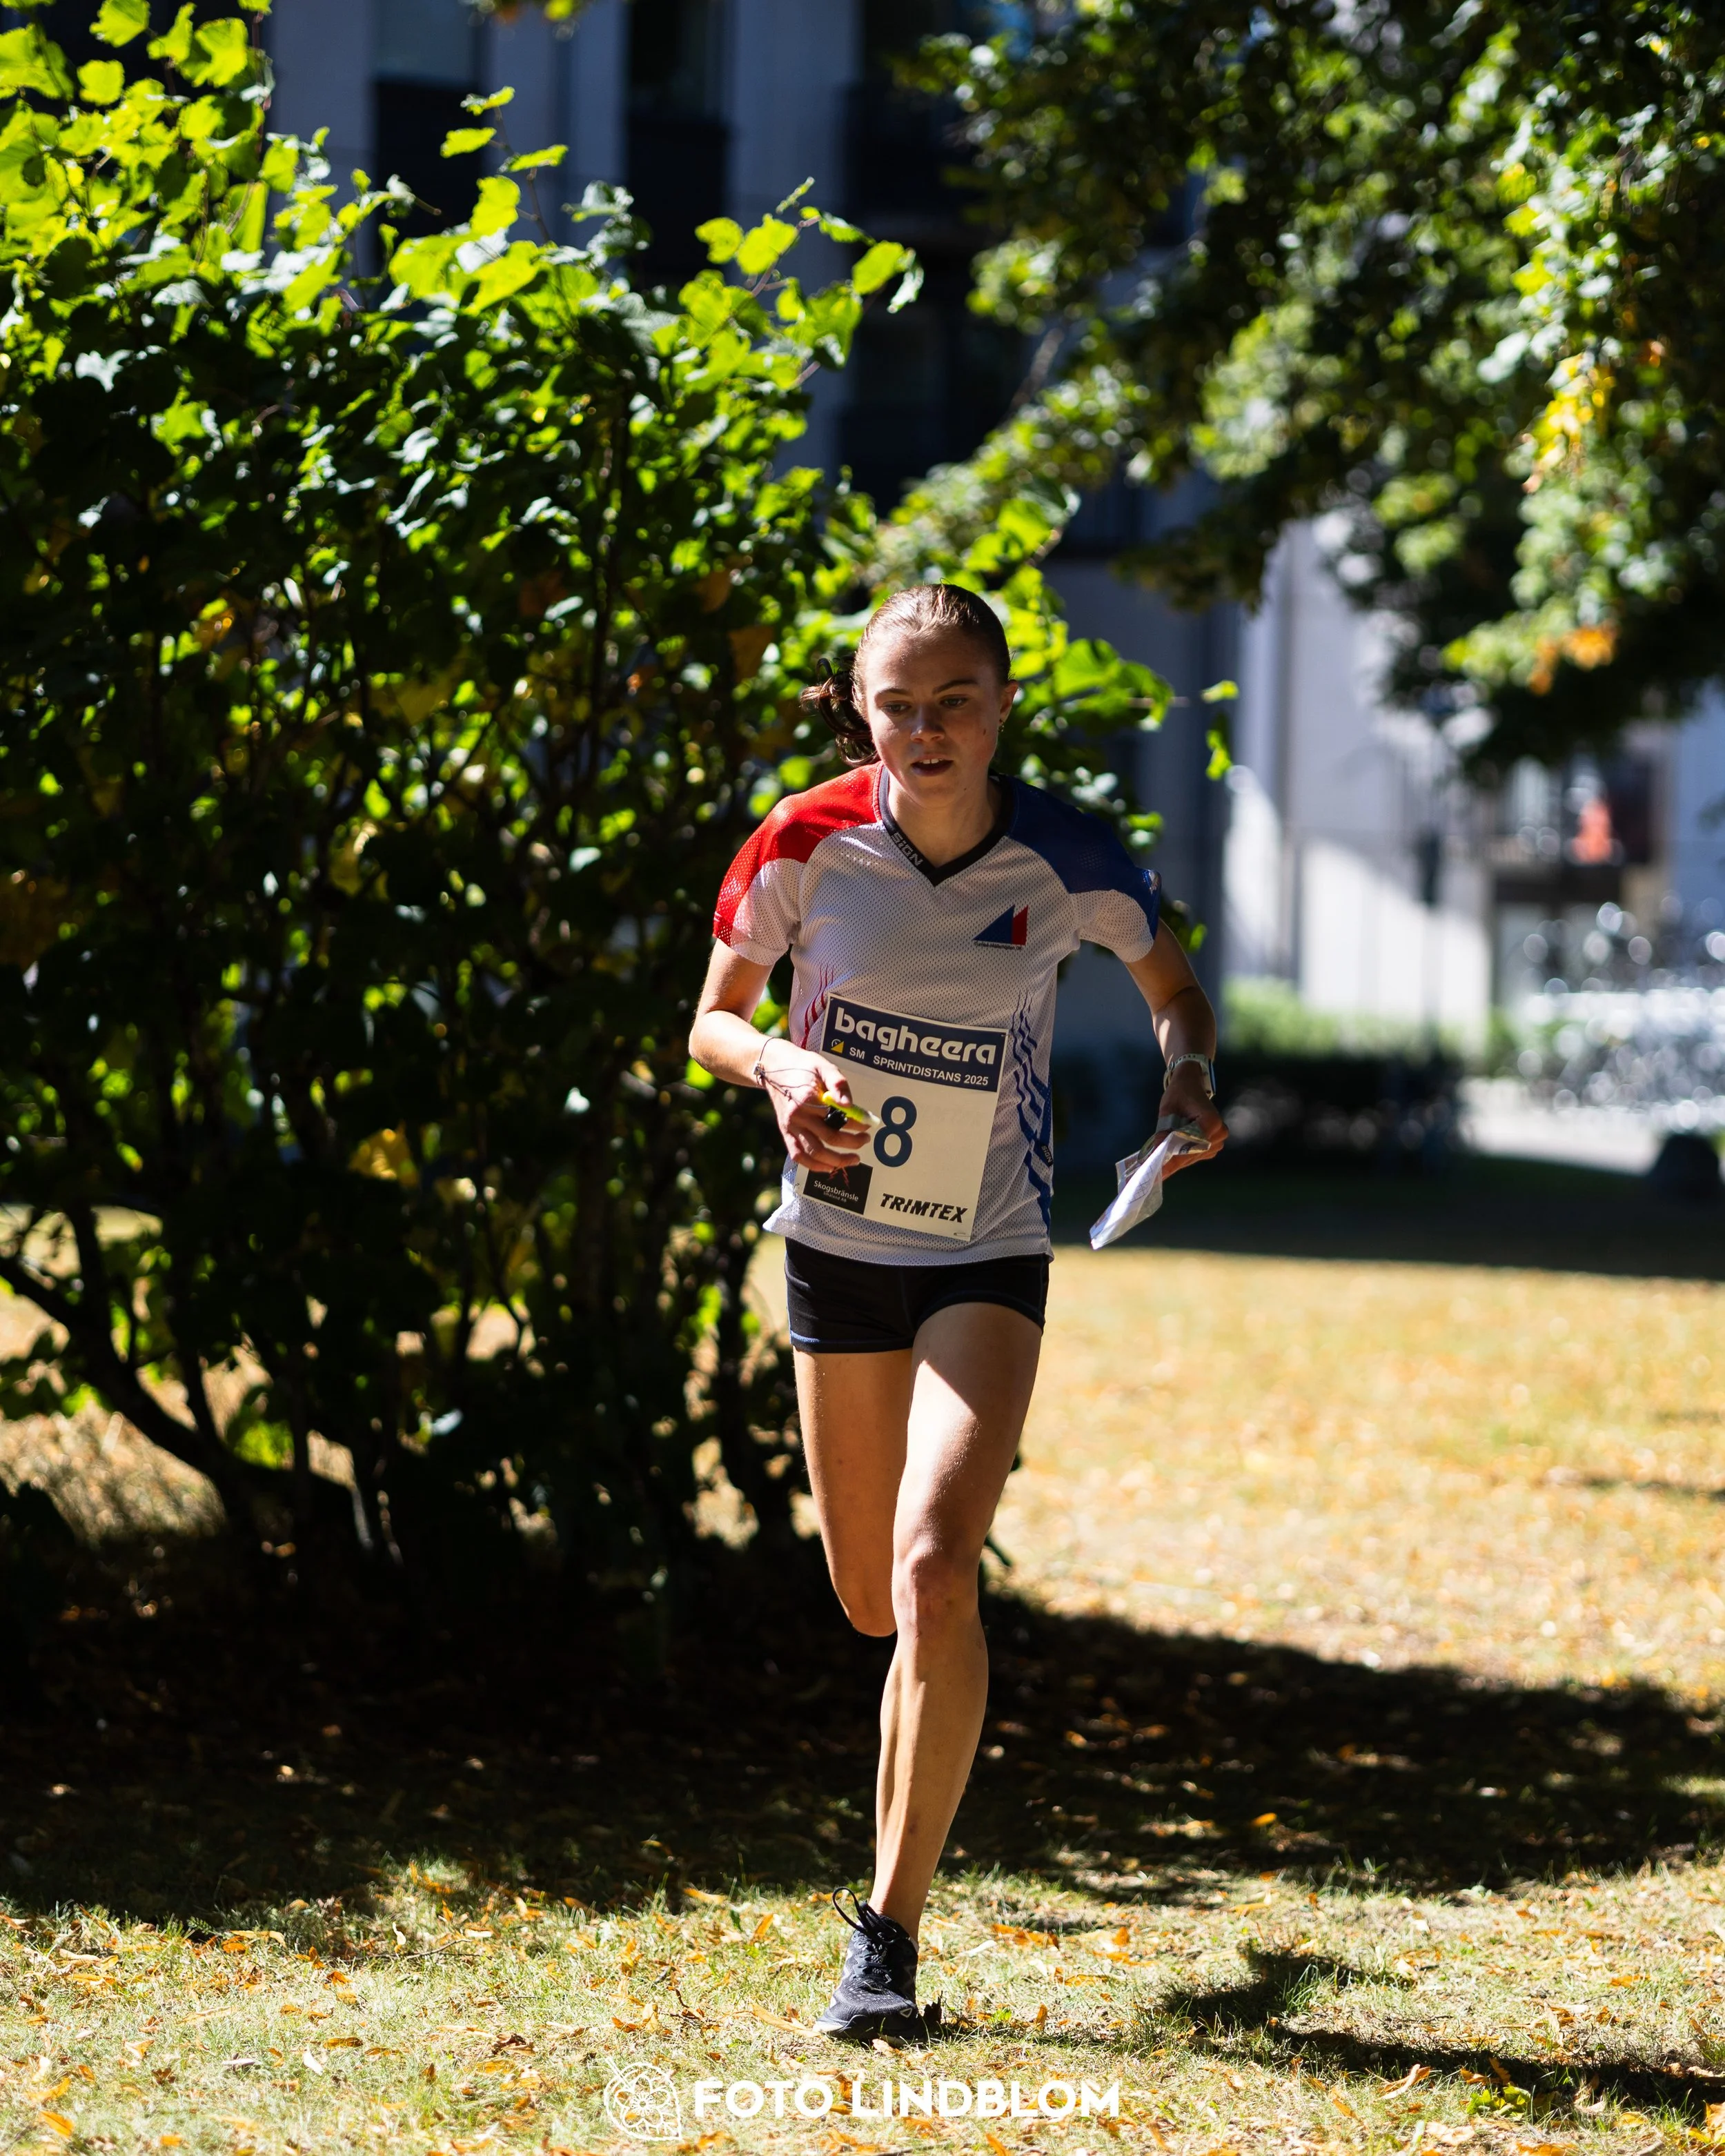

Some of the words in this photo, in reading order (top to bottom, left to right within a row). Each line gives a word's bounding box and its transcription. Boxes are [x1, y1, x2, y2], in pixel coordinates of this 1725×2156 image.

[835, 1007, 996, 1065] bagheera
[849, 1047, 865, 1060] SM
[873, 1055, 962, 1082] SPRINTDISTANS
[963, 1074, 989, 1087] 2025
[874, 1096, 917, 1167] 8
[814, 1180, 859, 1202] Skogsbränsle
[880, 1193, 968, 1223] TRIMTEX
